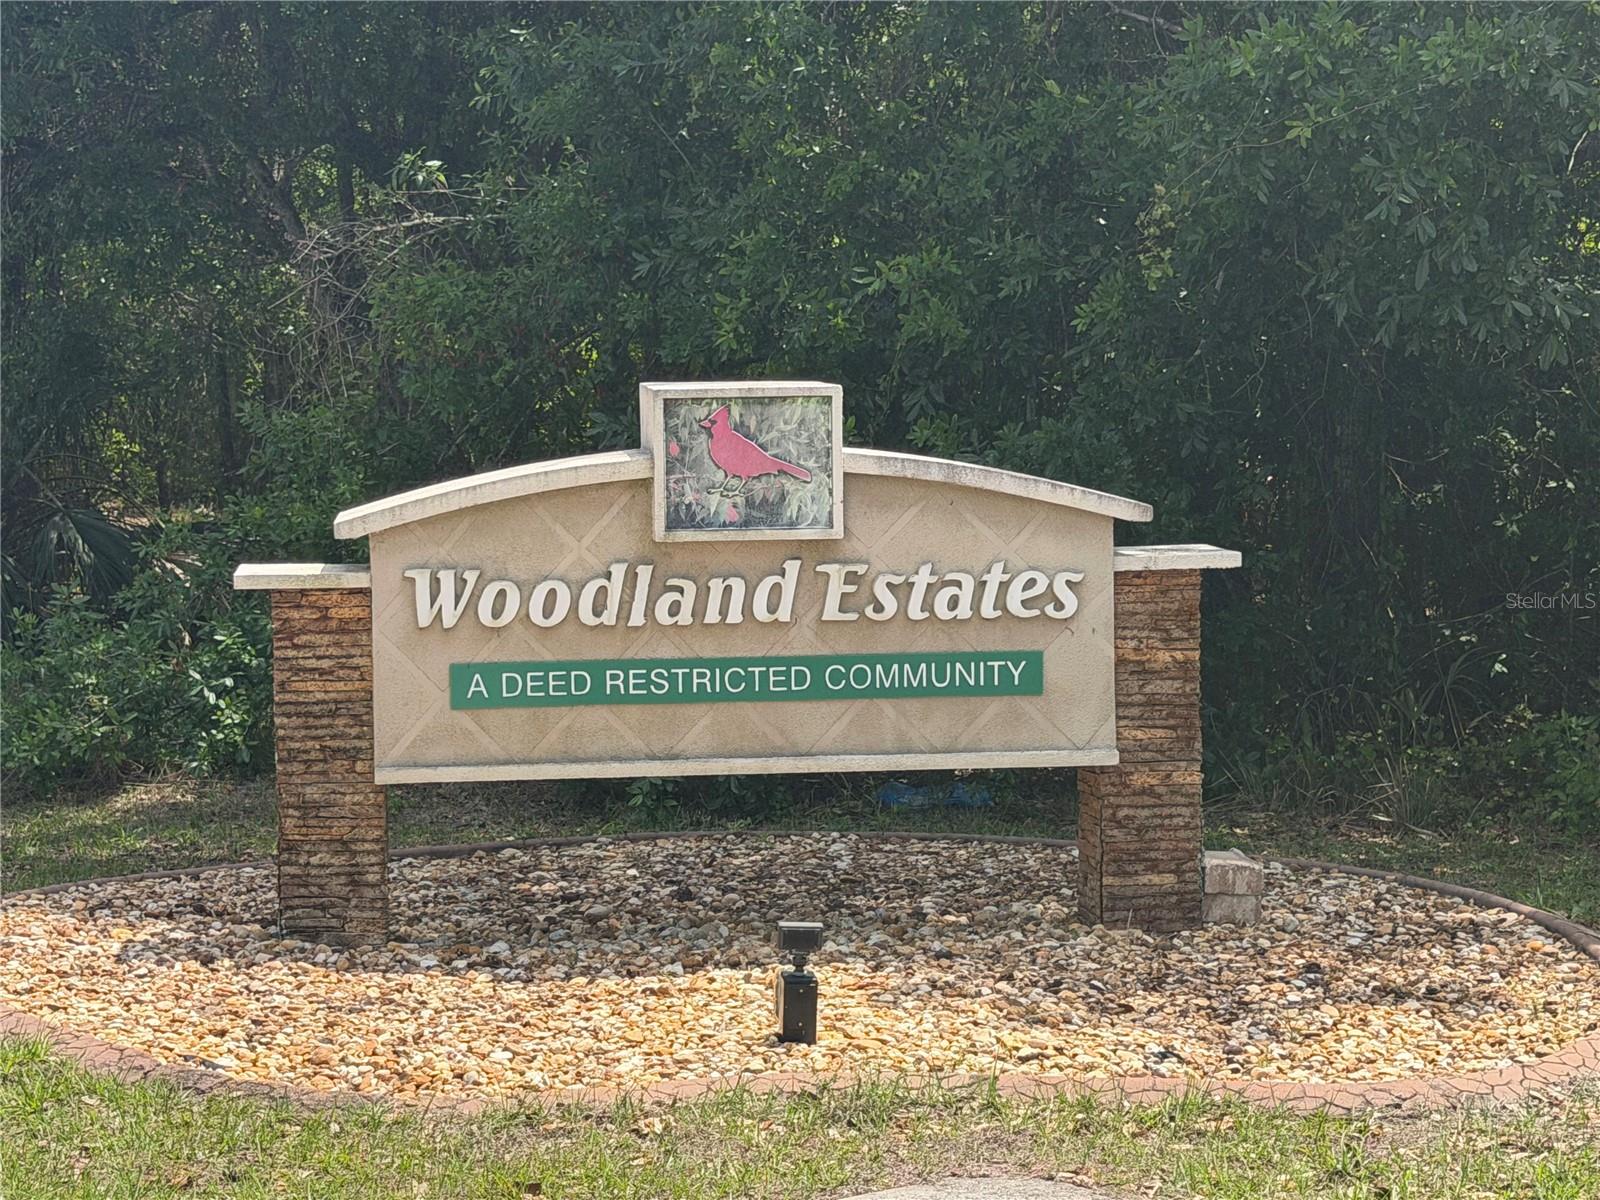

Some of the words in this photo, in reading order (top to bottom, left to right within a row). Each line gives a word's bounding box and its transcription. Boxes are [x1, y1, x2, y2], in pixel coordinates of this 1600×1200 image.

[404, 558, 801, 629] Woodland
[815, 560, 1084, 621] Estates
[467, 673, 489, 699] A
[502, 670, 591, 698] DEED
[606, 665, 811, 696] RESTRICTED
[825, 660, 1027, 690] COMMUNITY
